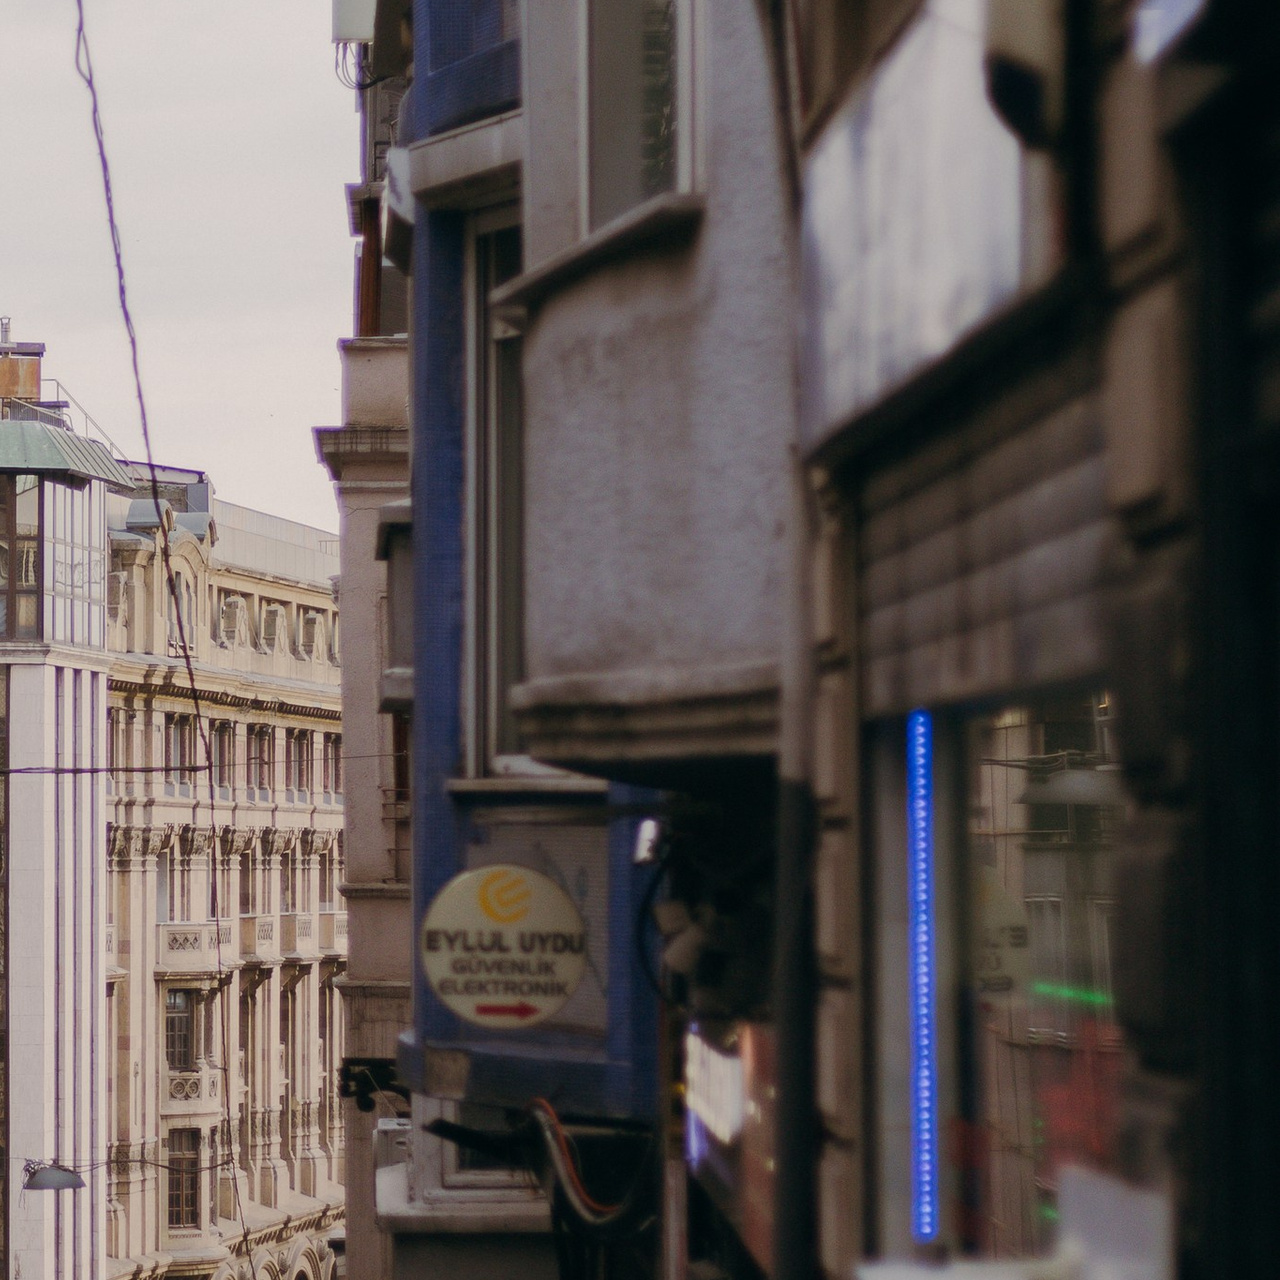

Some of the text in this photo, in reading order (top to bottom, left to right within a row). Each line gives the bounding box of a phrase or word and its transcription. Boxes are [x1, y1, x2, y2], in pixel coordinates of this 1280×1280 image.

[426, 929, 585, 954] EYLÜL UYDU
[452, 959, 555, 976] GÜVENLİK
